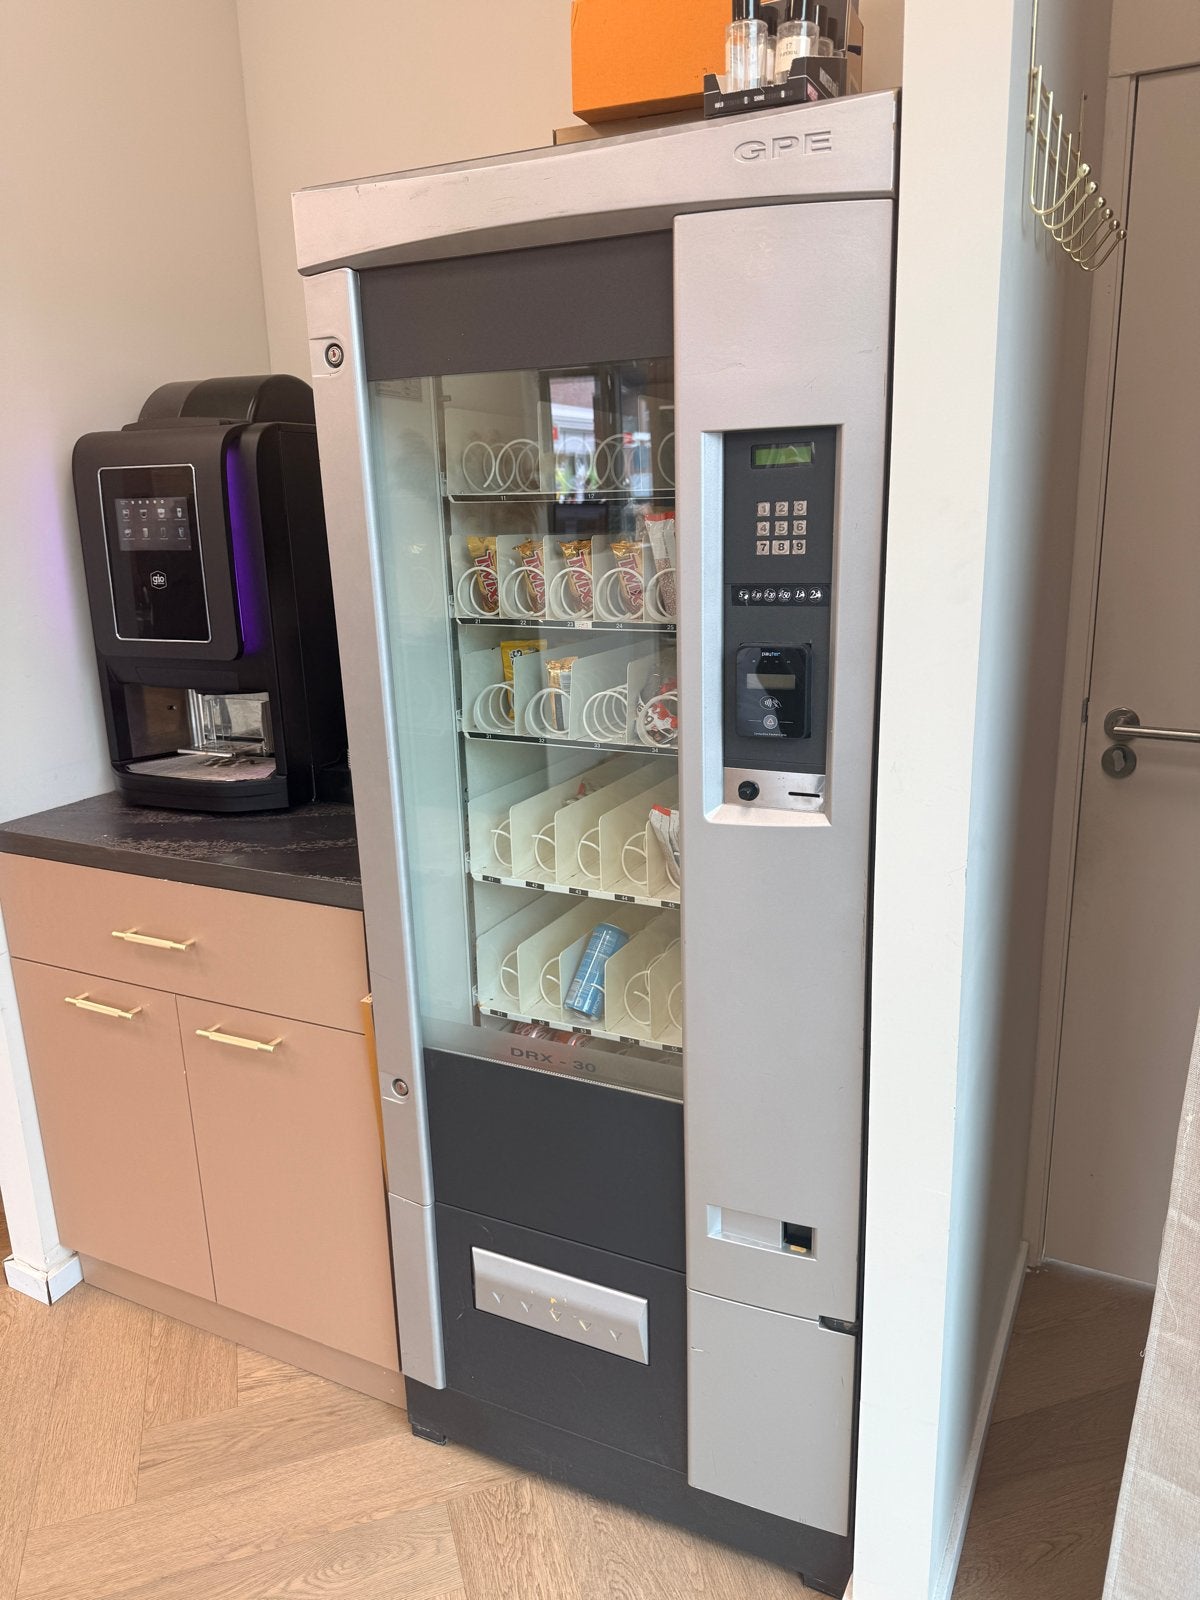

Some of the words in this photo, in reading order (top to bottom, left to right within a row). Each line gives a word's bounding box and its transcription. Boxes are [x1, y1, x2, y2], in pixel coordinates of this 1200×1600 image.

[732, 130, 832, 164] GPE
[761, 504, 767, 513] 1
[778, 503, 786, 513] 2
[796, 502, 804, 512] 3
[760, 523, 768, 533] 4
[778, 523, 786, 532] 5
[796, 522, 804, 532] 6
[760, 543, 767, 551] 7
[778, 542, 785, 551] 8
[796, 542, 804, 551] 9
[152, 574, 165, 585] gio
[567, 549, 593, 603] TWIX
[618, 552, 644, 606] TWIX
[510, 1047, 553, 1064] DRX
[573, 1060, 596, 1073] 30
